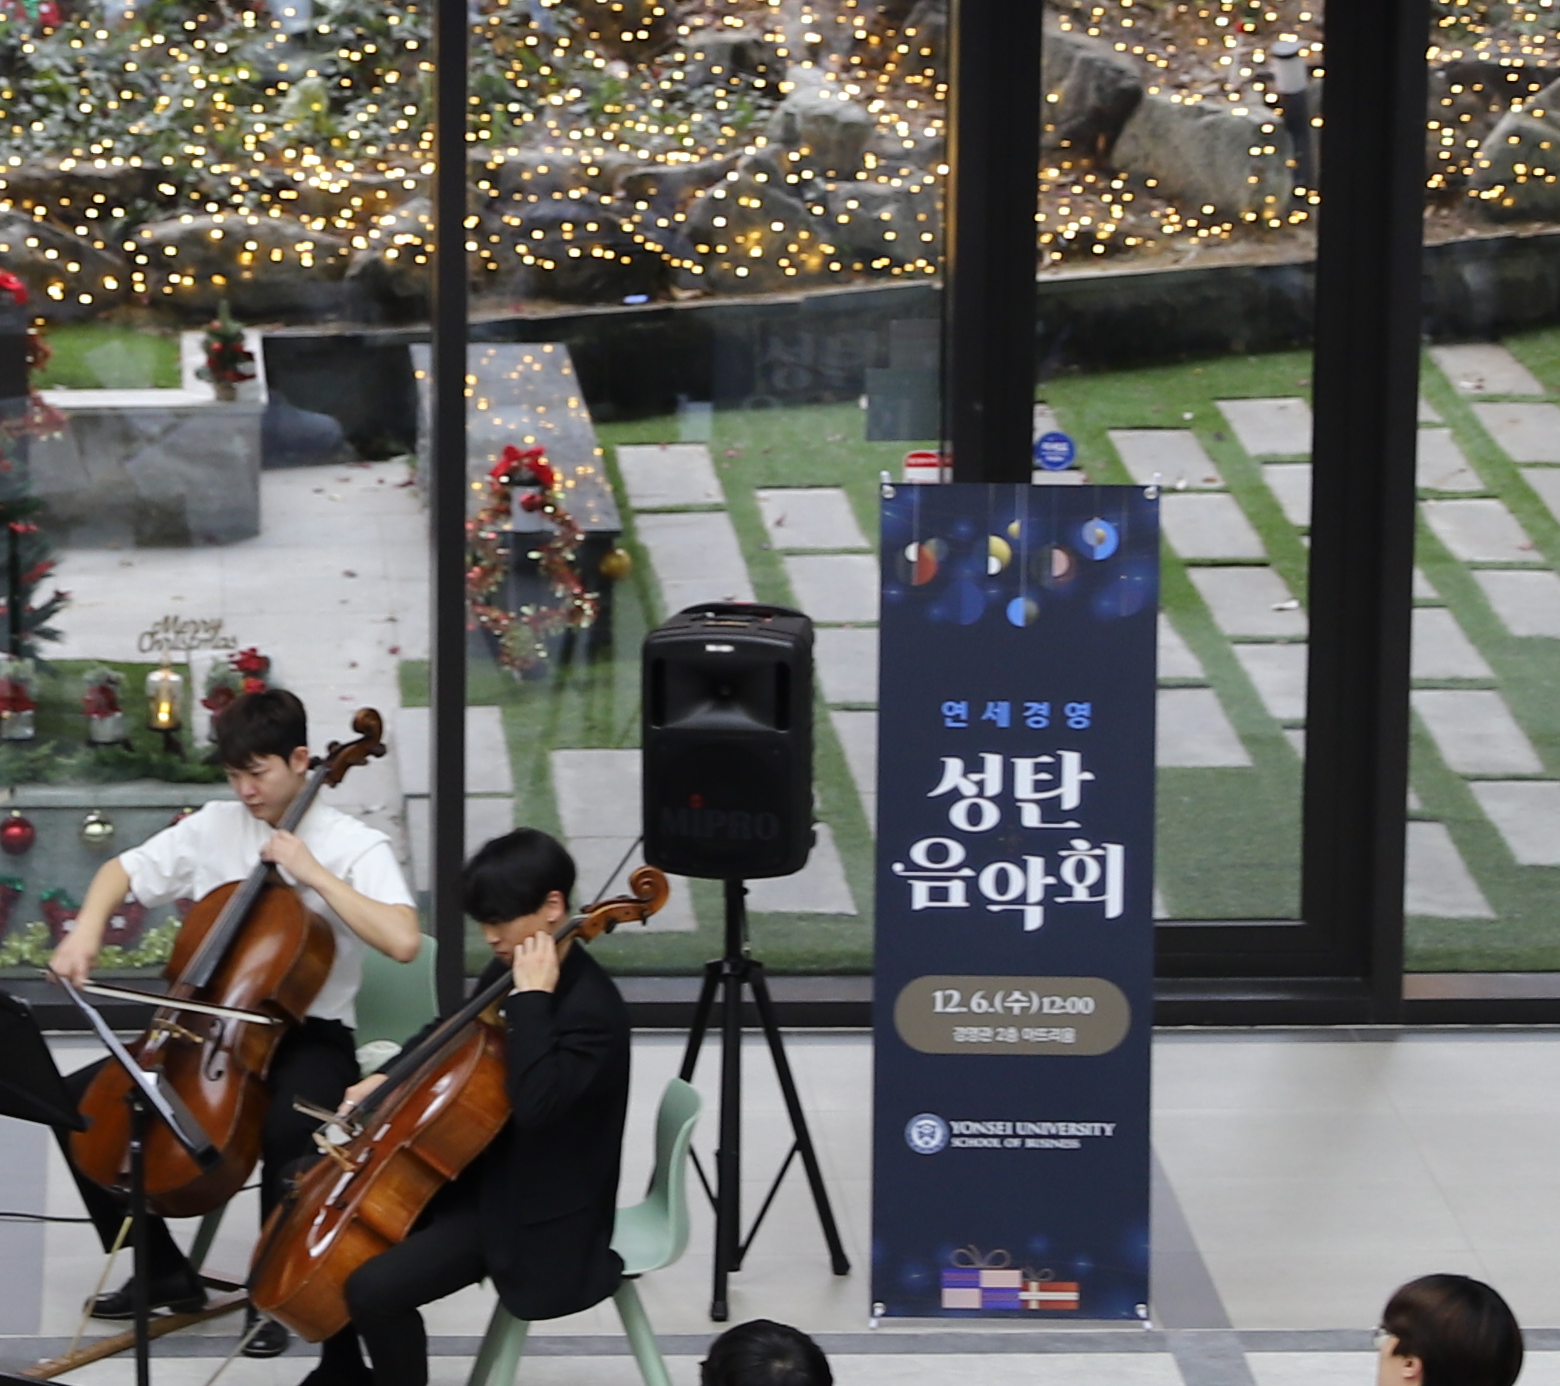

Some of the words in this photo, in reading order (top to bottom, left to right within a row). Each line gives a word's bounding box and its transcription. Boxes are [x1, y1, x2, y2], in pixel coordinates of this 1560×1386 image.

[926, 749, 1096, 833] 성탄
[891, 836, 1126, 933] 음악회
[949, 1120, 1015, 1136] YONSEI
[1016, 1121, 1117, 1138] UNIVERSITY
[950, 1137, 1002, 1149] SCHOOL
[1002, 1138, 1023, 1149] OF
